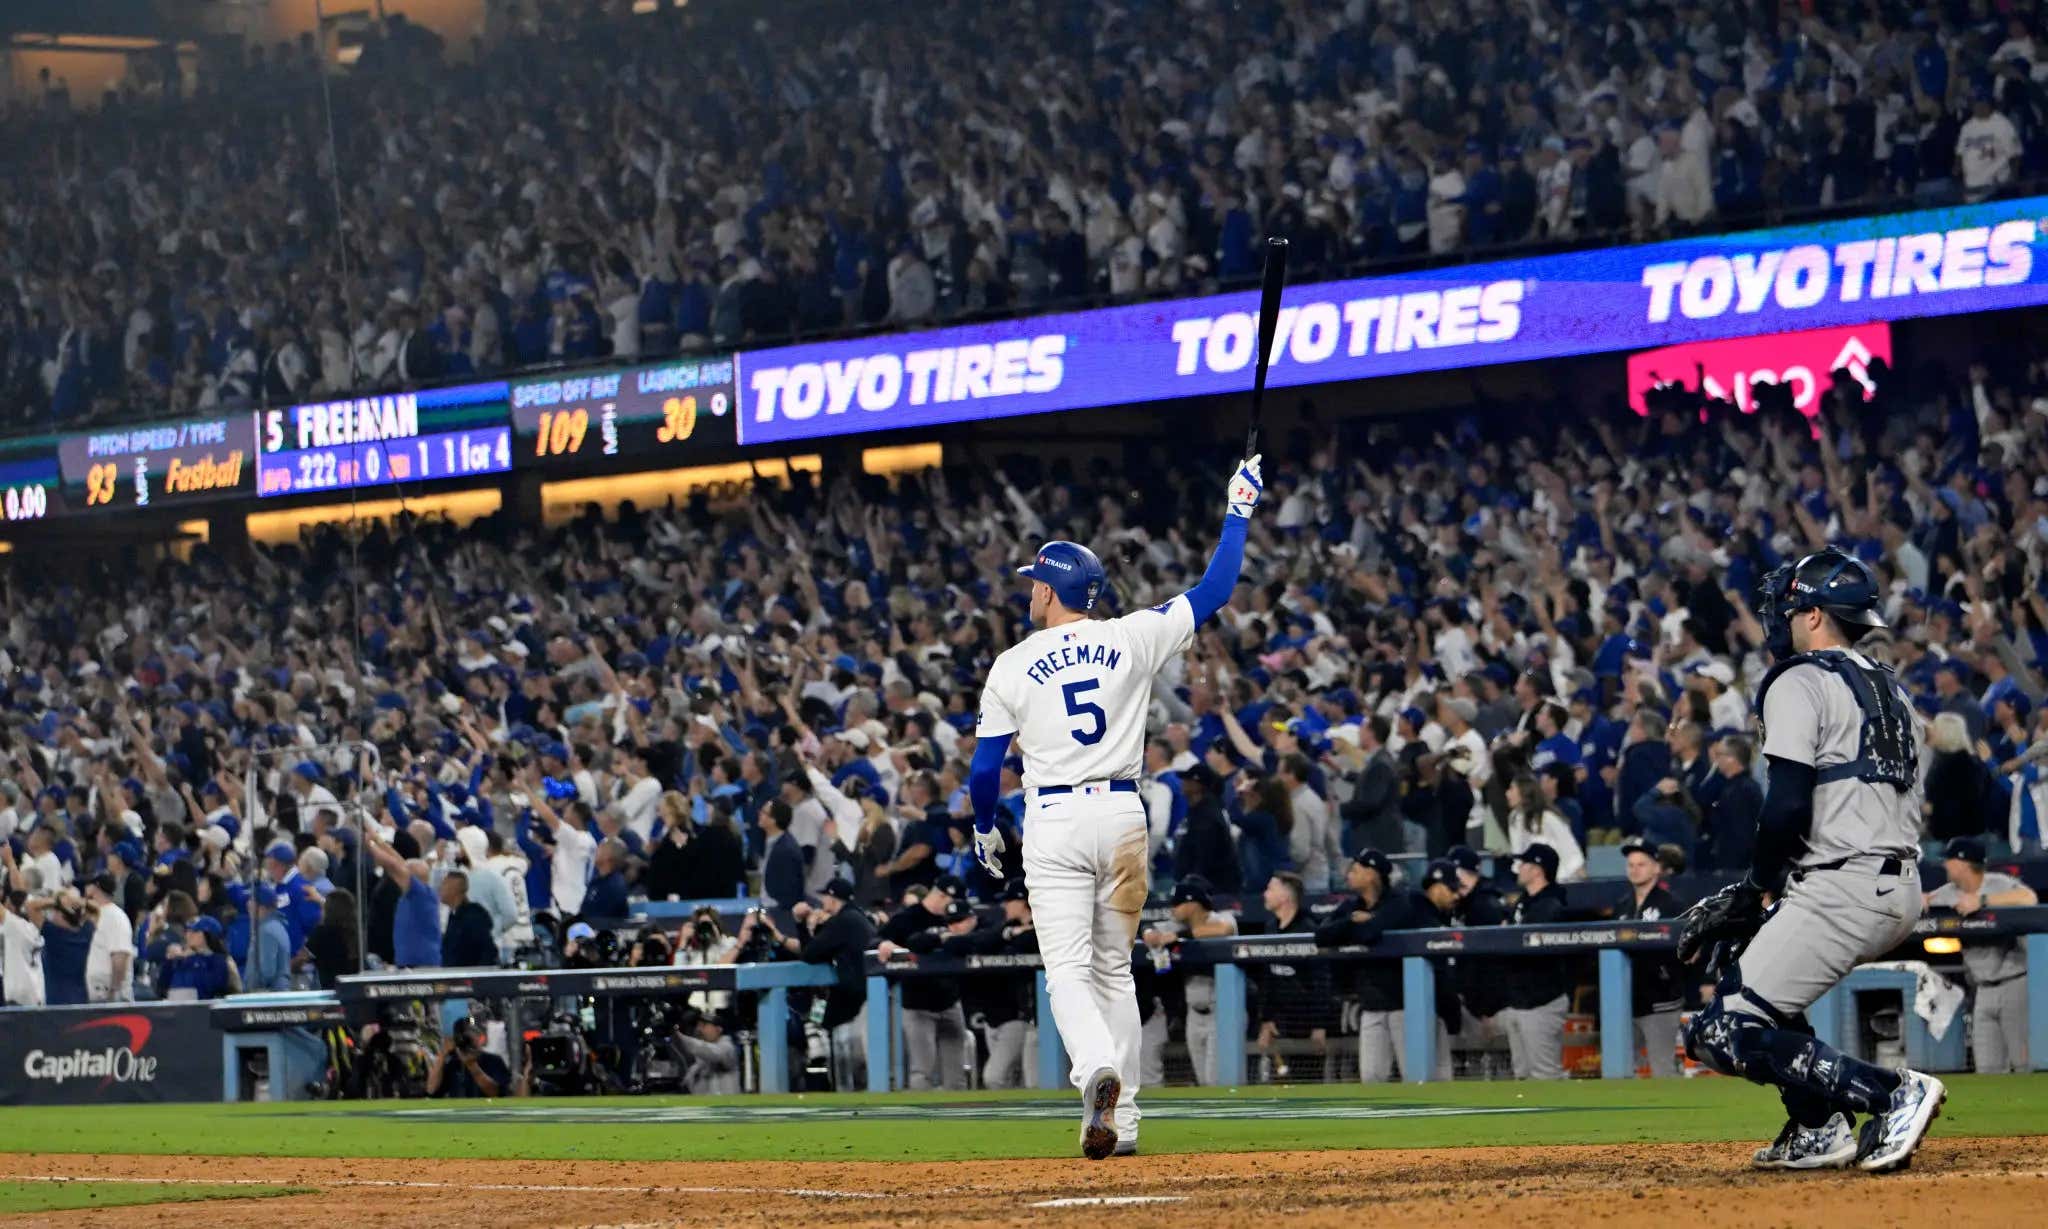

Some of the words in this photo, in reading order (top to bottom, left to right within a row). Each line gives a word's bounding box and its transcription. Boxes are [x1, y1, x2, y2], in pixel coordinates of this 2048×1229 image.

[1642, 244, 1830, 323] TOYO
[1835, 220, 2036, 302] TIRES
[1344, 279, 1524, 357] TIRES
[513, 381, 562, 408] SPEED
[562, 378, 591, 403] OFF
[591, 374, 621, 399] BAT
[637, 366, 698, 393] LAUNCH
[751, 354, 902, 423] TOYO
[905, 334, 1066, 406] TIRES
[189, 421, 227, 446] TYPE
[266, 410, 284, 453] 5
[297, 393, 419, 449] FREEMAN
[536, 408, 589, 457] 109
[656, 395, 697, 443] 30
[166, 450, 243, 494] Fastball
[295, 452, 337, 489] .222
[417, 441, 429, 476] 1
[461, 434, 491, 471] for
[495, 431, 510, 468] 4
[6, 483, 47, 521] 0.00
[87, 463, 117, 506] 93
[1044, 557, 1073, 572] STRAUSS
[1086, 599, 1095, 610] 5
[1027, 645, 1122, 685] FREEMAN
[1061, 677, 1107, 746] 5
[1248, 944, 1284, 957] WORLD
[1285, 942, 1318, 956] SERIES
[1541, 932, 1579, 946] WORLD
[1580, 930, 1617, 945] SERIES
